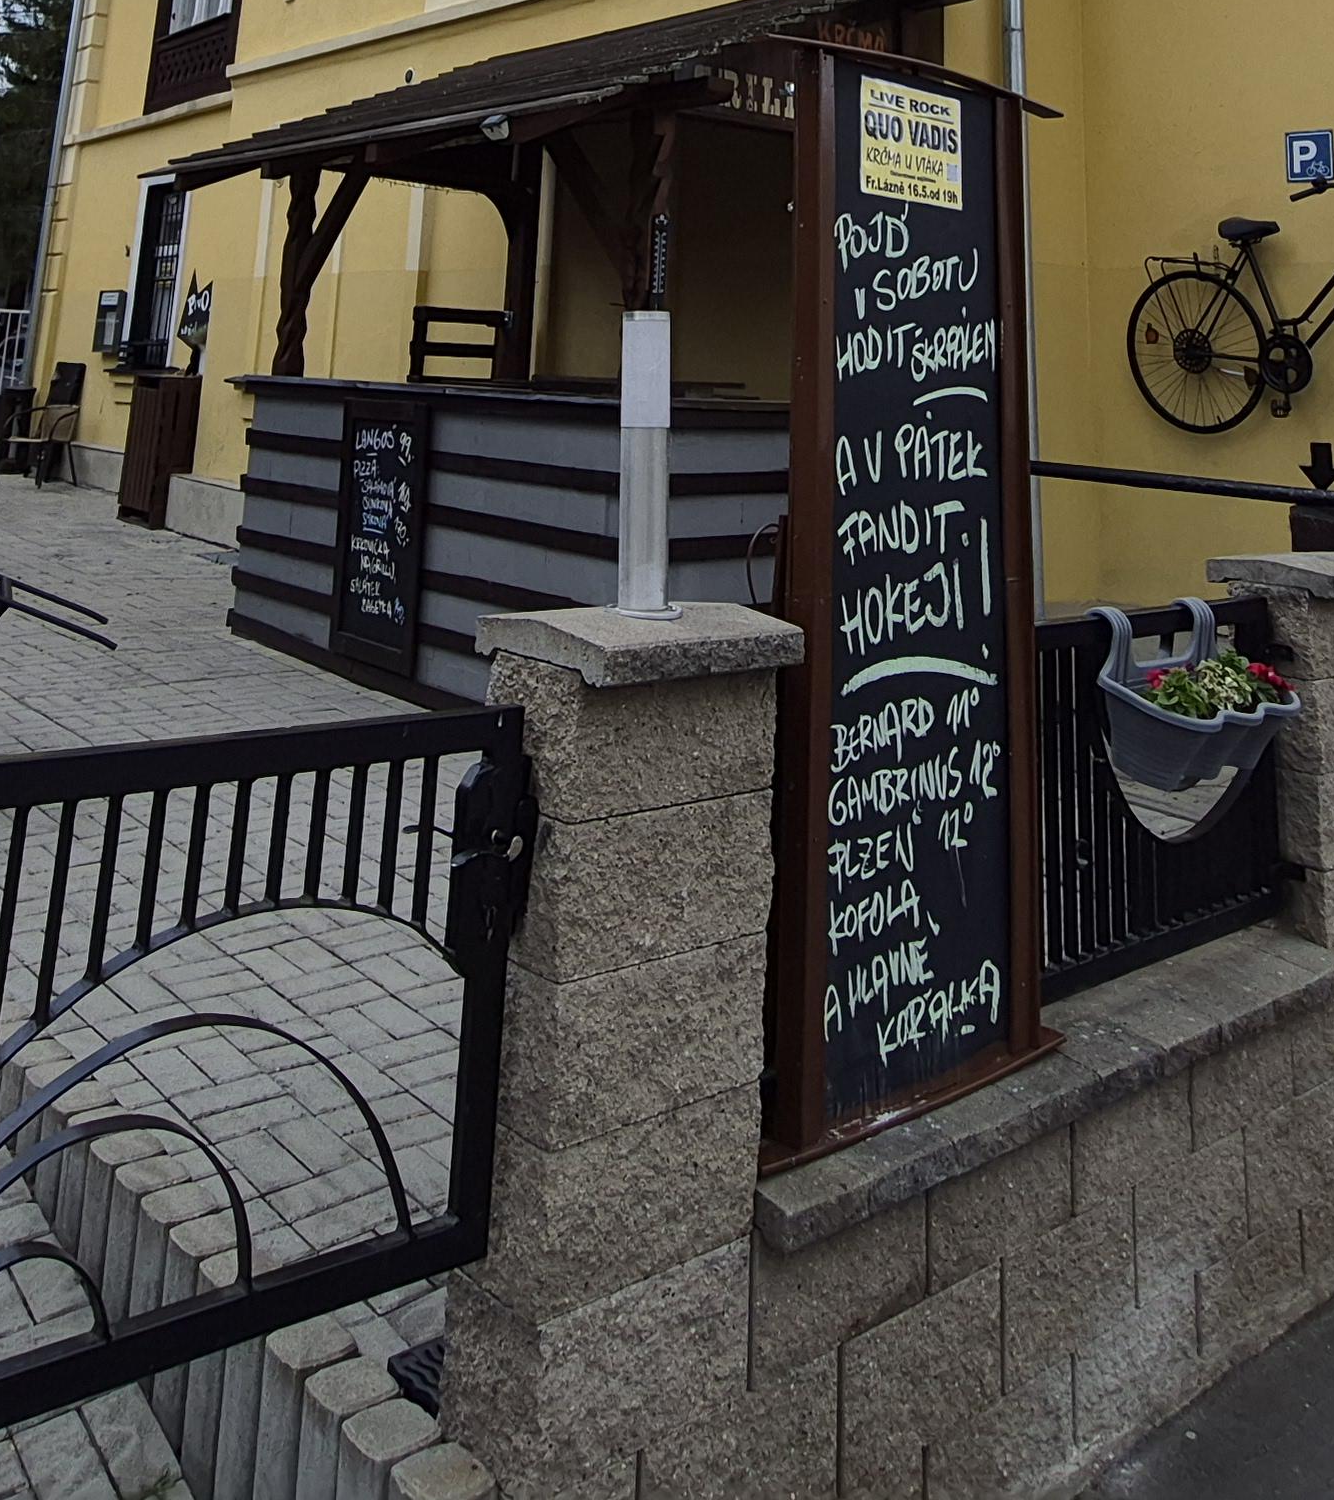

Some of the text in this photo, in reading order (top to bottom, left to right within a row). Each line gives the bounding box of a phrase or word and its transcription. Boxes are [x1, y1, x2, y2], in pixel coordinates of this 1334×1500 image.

[865, 109, 959, 155] QUO VADIS
[870, 89, 951, 117] LIVE ROCK
[867, 145, 901, 169] KRČMA
[1292, 140, 1318, 174] P
[942, 189, 958, 205] 19h
[872, 248, 979, 312] SOBOTU
[836, 322, 916, 382] HODIT
[835, 410, 988, 496] A V PÁTEK
[830, 697, 935, 774] BERNARD
[828, 747, 963, 826] GAMBRINUS
[824, 984, 843, 1043] A
